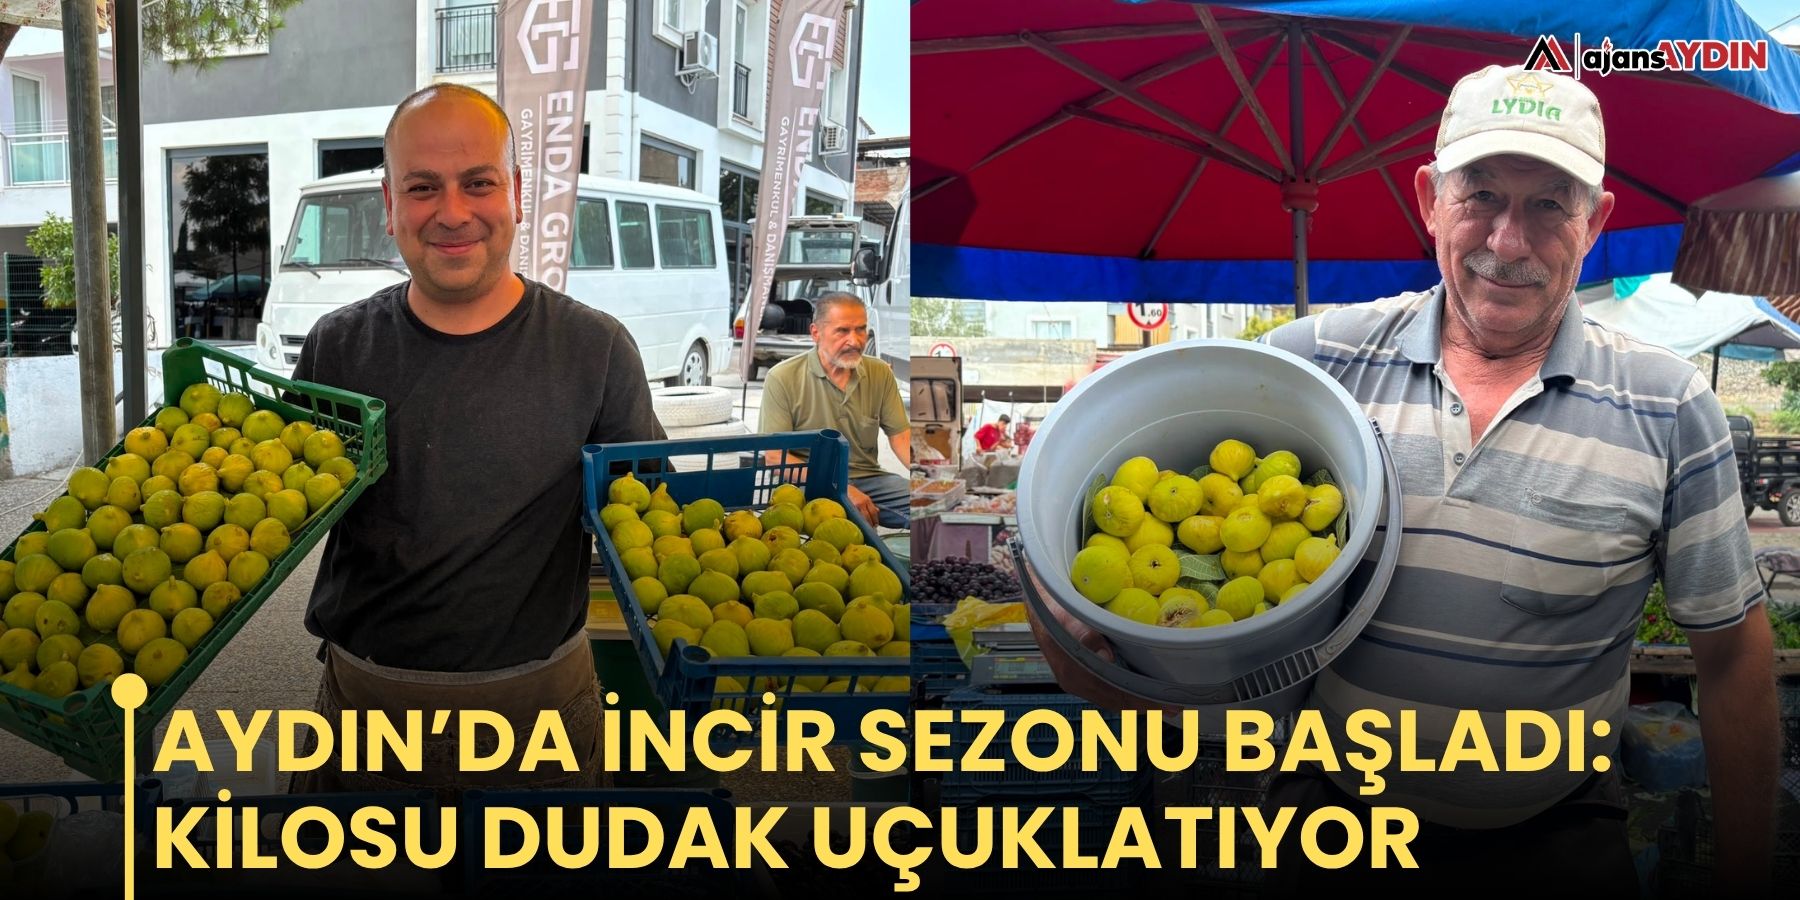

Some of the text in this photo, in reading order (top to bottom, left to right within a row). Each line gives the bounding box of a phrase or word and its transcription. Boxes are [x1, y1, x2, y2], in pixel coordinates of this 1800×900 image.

[1491, 97, 1562, 121] LYDIA
[543, 90, 574, 202] ENDA
[769, 116, 790, 218] GAYRİMENKUL
[519, 222, 531, 232] &
[767, 220, 778, 230] &
